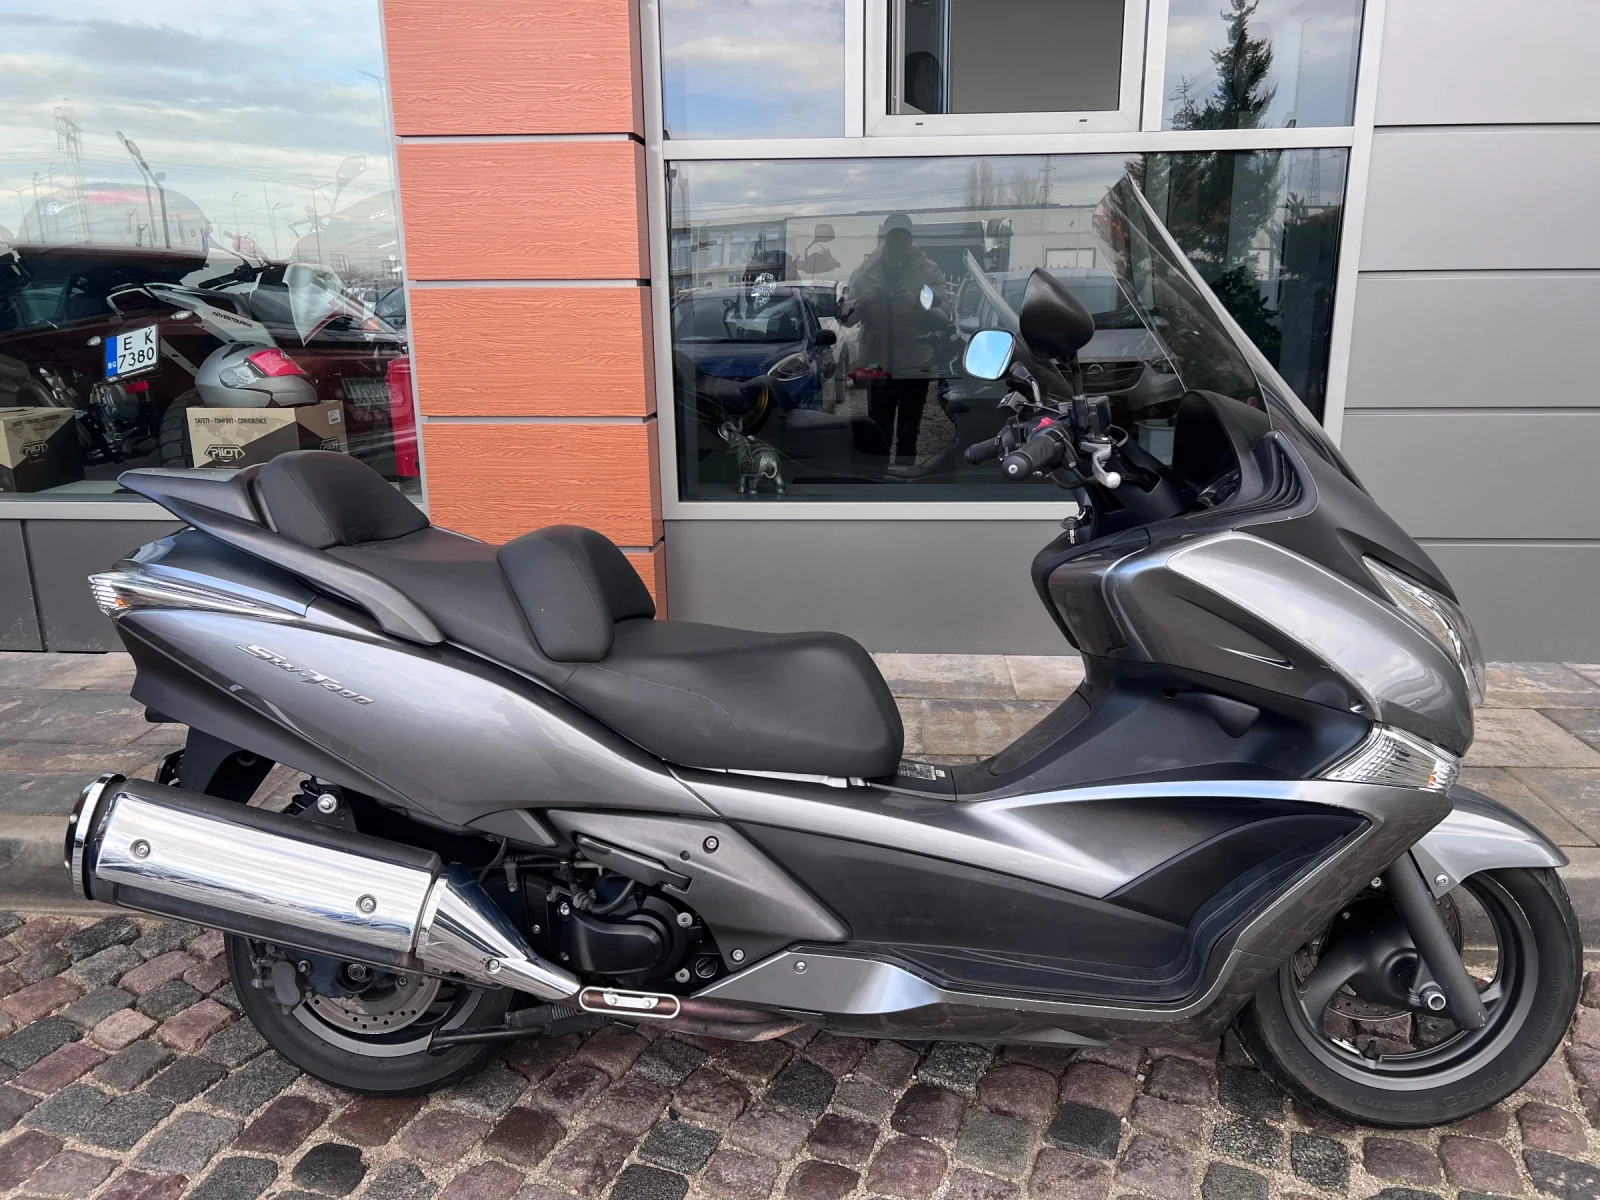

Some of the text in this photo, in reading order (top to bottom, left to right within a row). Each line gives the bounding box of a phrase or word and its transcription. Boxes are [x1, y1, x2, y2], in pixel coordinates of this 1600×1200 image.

[123, 330, 153, 351] E K
[107, 360, 117, 370] BG
[118, 346, 155, 370] 7380
[1443, 1068, 1510, 1108] ROSSO
